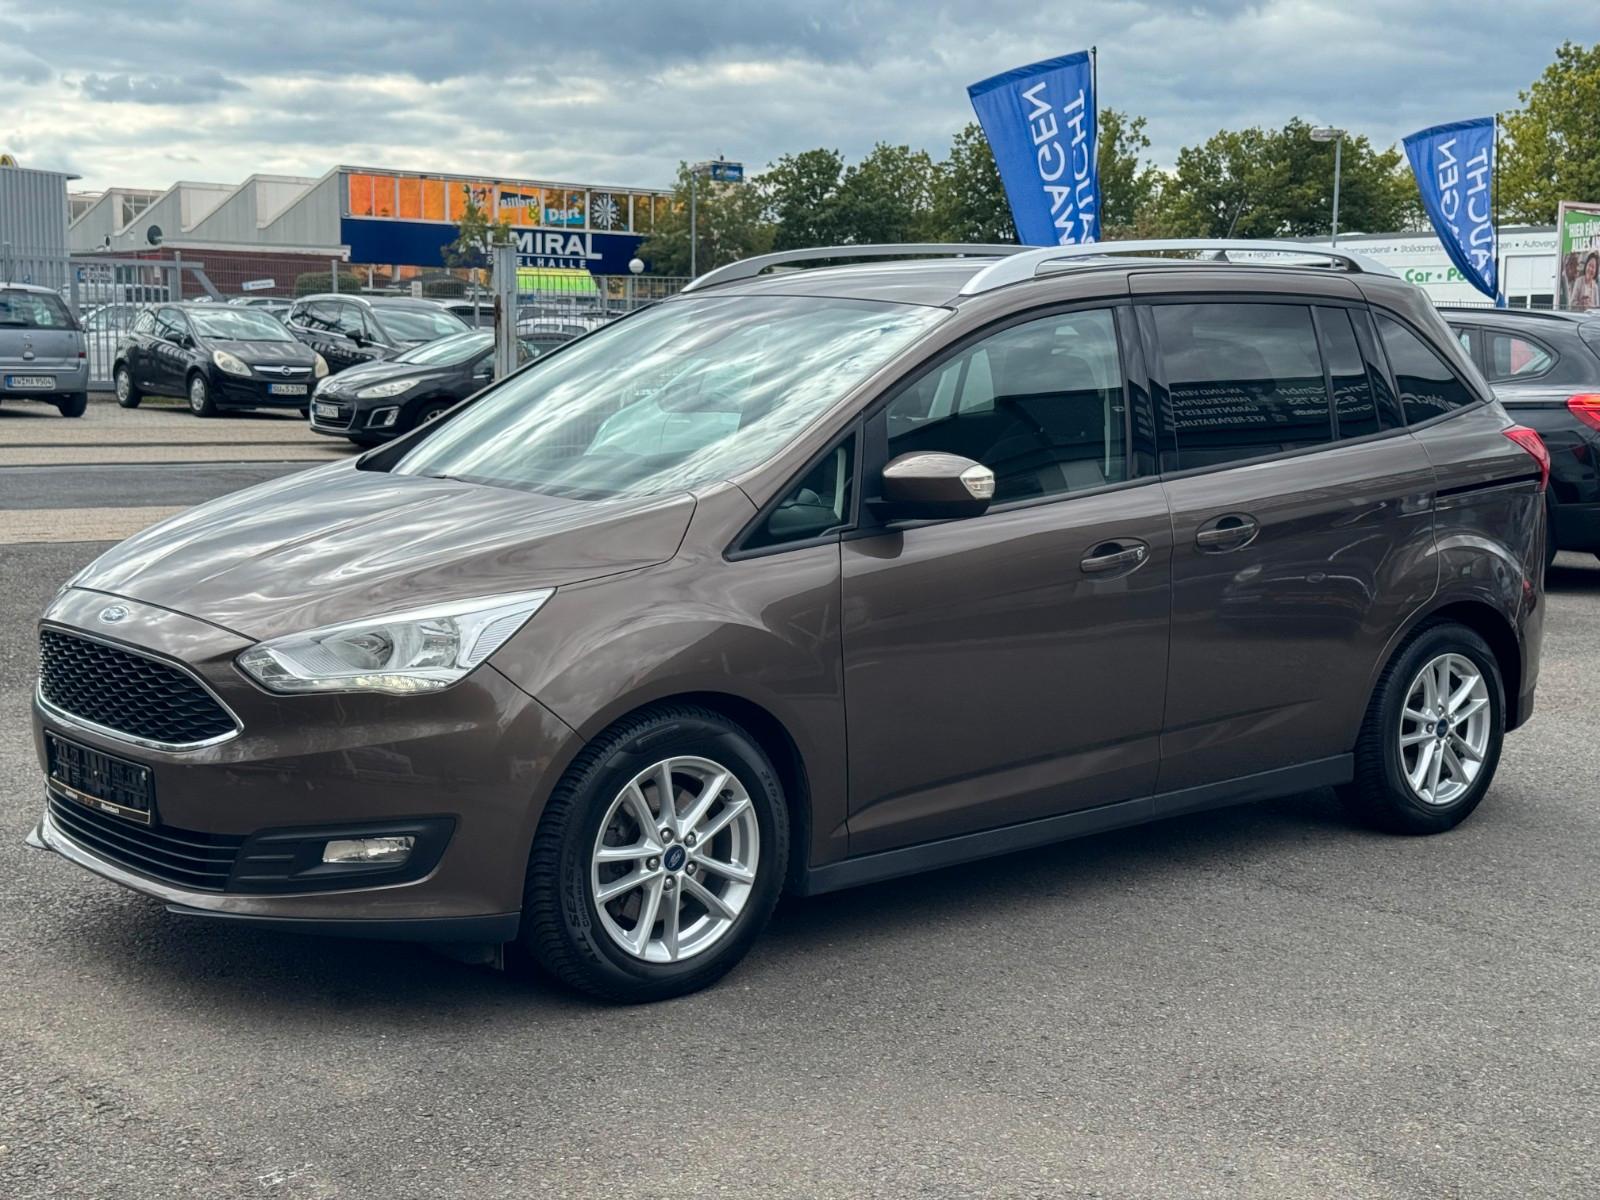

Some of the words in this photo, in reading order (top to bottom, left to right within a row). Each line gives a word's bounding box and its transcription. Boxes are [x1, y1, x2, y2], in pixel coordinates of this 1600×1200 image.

[549, 208, 580, 222] Dart
[459, 231, 602, 260] AMIRAL
[486, 256, 587, 269] SELHALLE
[1405, 268, 1433, 282] Car
